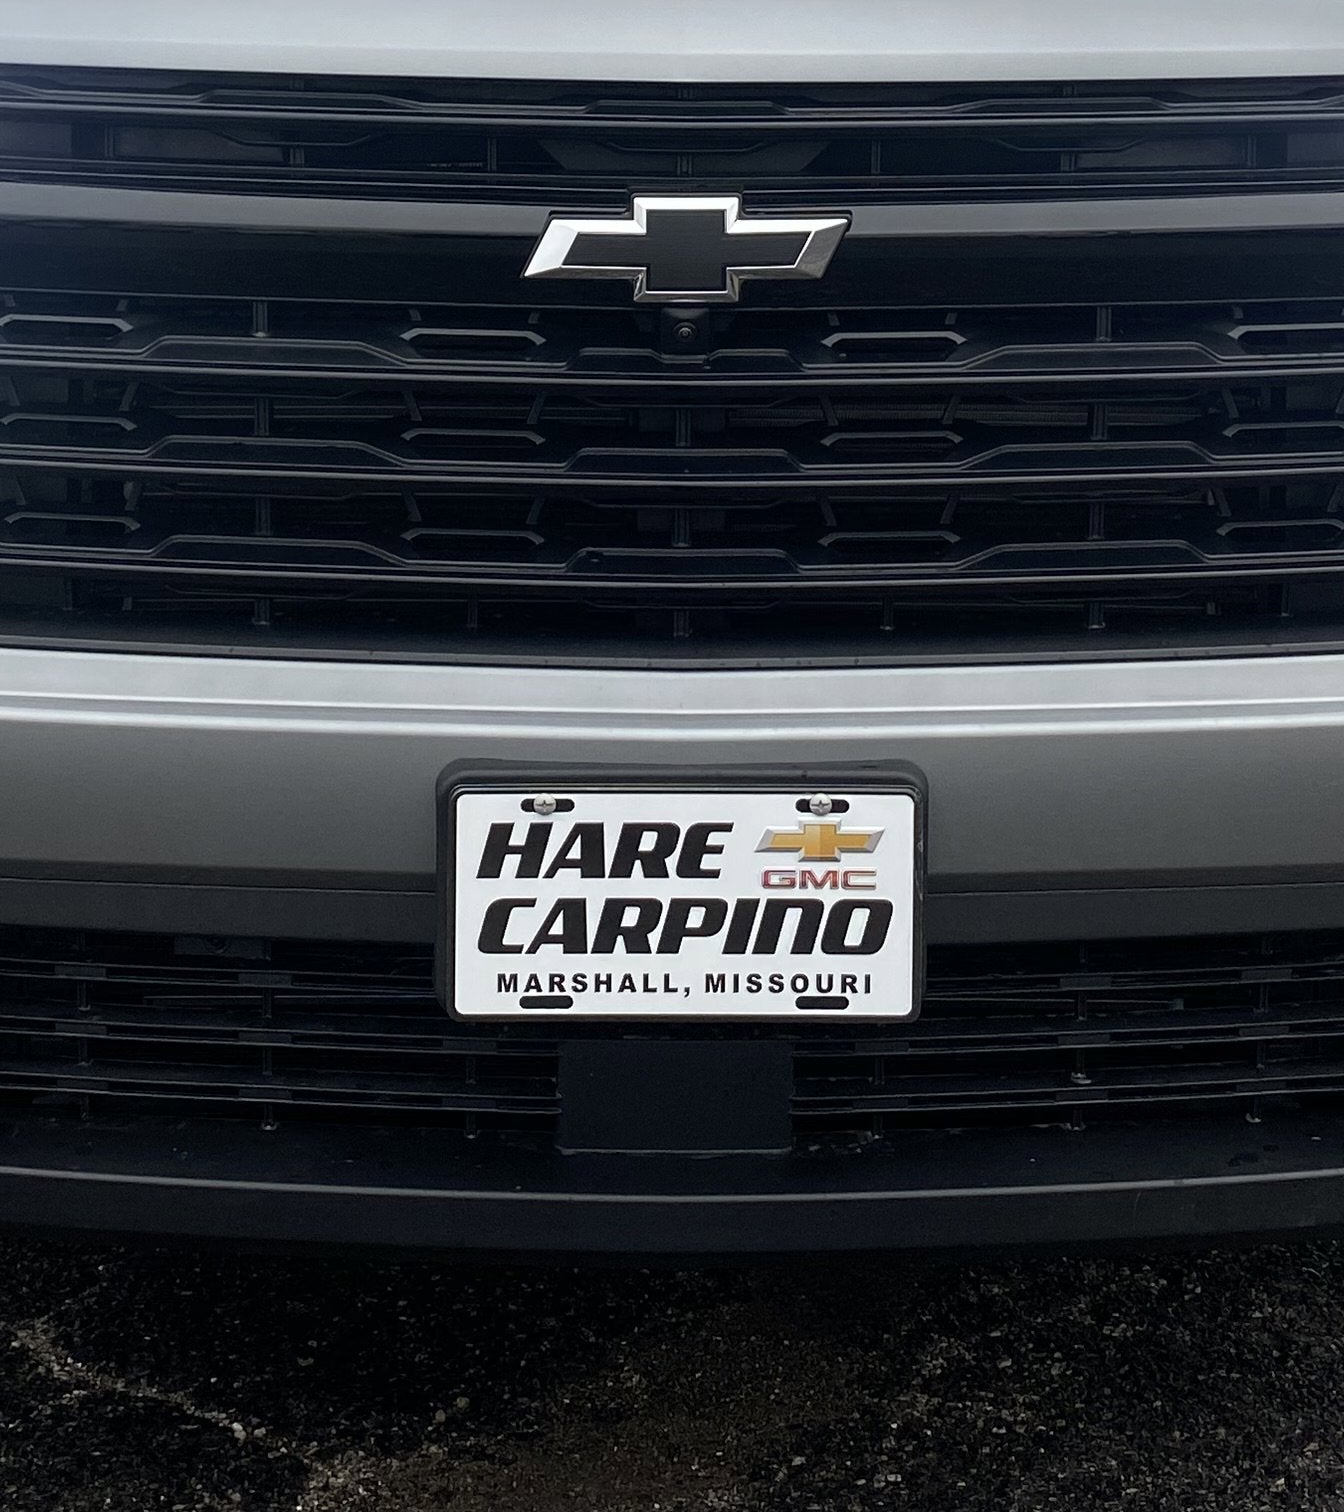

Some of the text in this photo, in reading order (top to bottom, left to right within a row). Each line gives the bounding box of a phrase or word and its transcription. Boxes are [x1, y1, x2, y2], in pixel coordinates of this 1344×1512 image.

[476, 821, 734, 879] HARE
[760, 868, 878, 890] GMC
[477, 897, 894, 955] CARPINO
[496, 973, 872, 997] MARSHALL, MISSOURI
